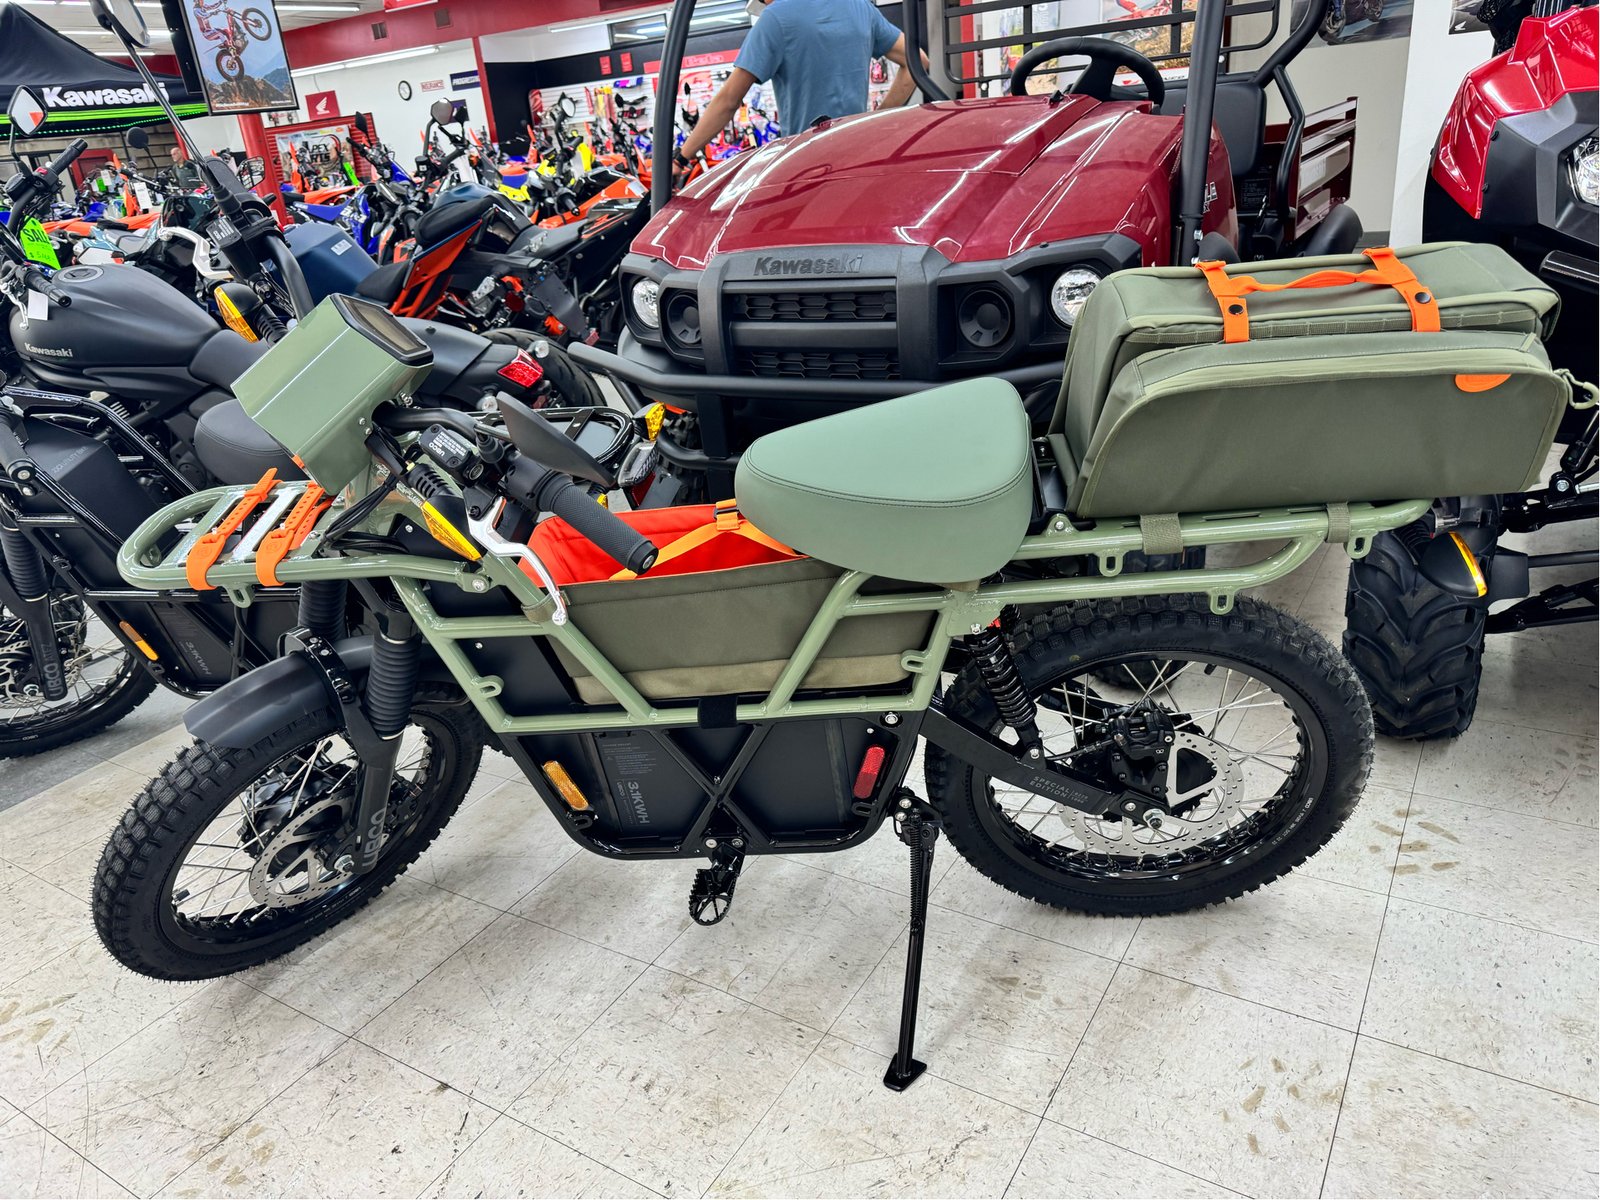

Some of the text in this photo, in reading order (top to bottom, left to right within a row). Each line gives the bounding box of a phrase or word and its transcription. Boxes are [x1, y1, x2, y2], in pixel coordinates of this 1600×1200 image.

[42, 82, 170, 108] Kawasaki
[753, 255, 864, 277] Kawasaki
[24, 342, 74, 358] Kawasaki
[428, 442, 446, 457] UBCO
[43, 662, 64, 697] UBCO
[1029, 780, 1069, 798] EDITION
[1033, 776, 1071, 794] SPECIAL
[628, 781, 651, 824] 3.1KWH
[362, 806, 388, 867] UBCO
